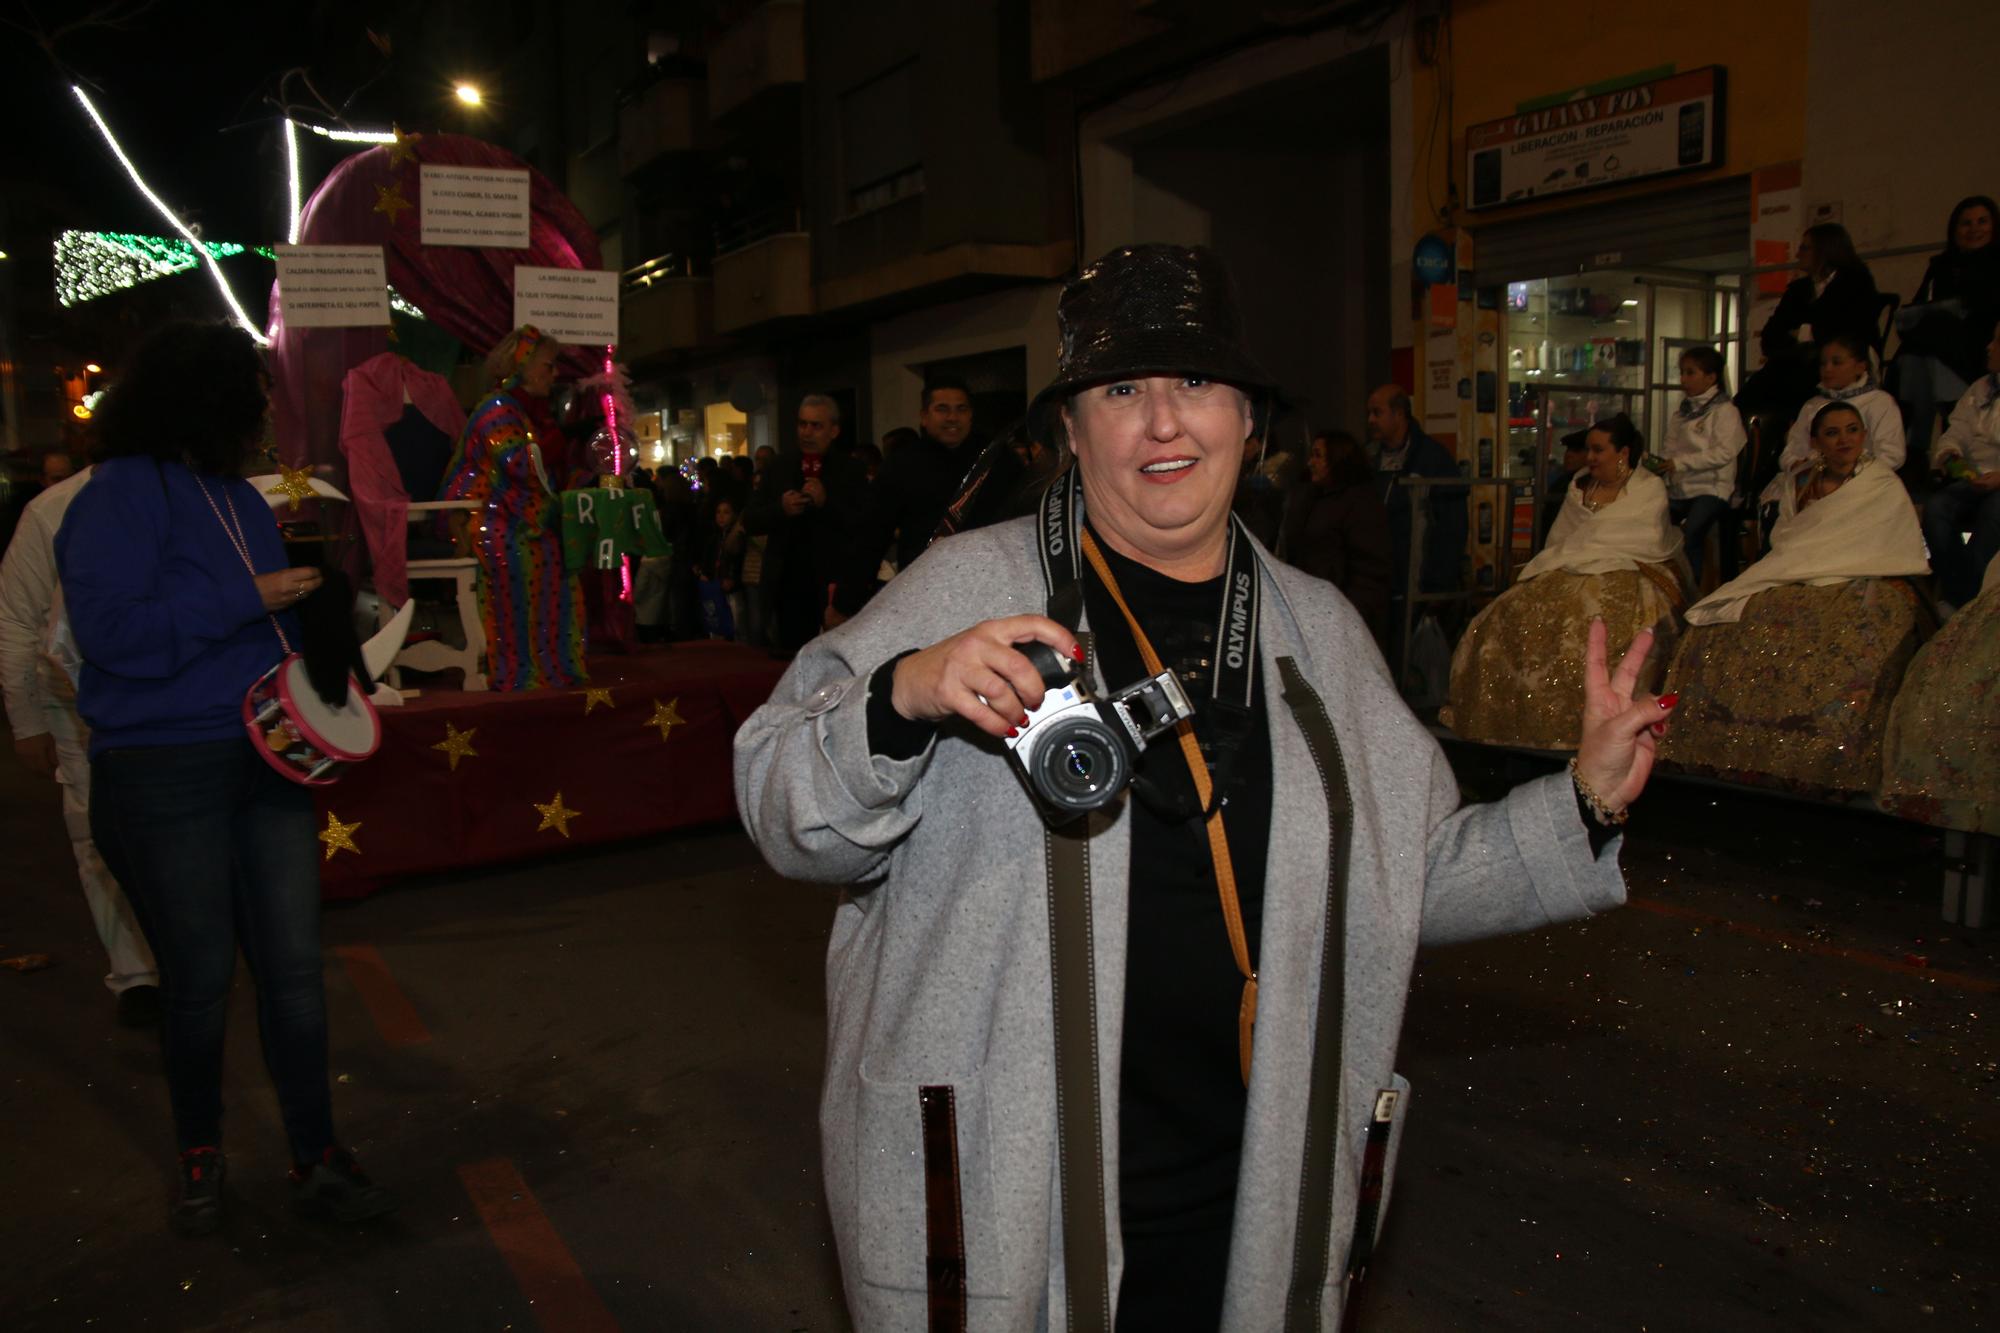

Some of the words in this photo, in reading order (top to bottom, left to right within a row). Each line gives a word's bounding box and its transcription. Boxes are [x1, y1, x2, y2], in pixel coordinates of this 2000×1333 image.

[577, 493, 594, 524] R
[598, 539, 614, 570] A
[1226, 571, 1250, 669] OLYMPUS
